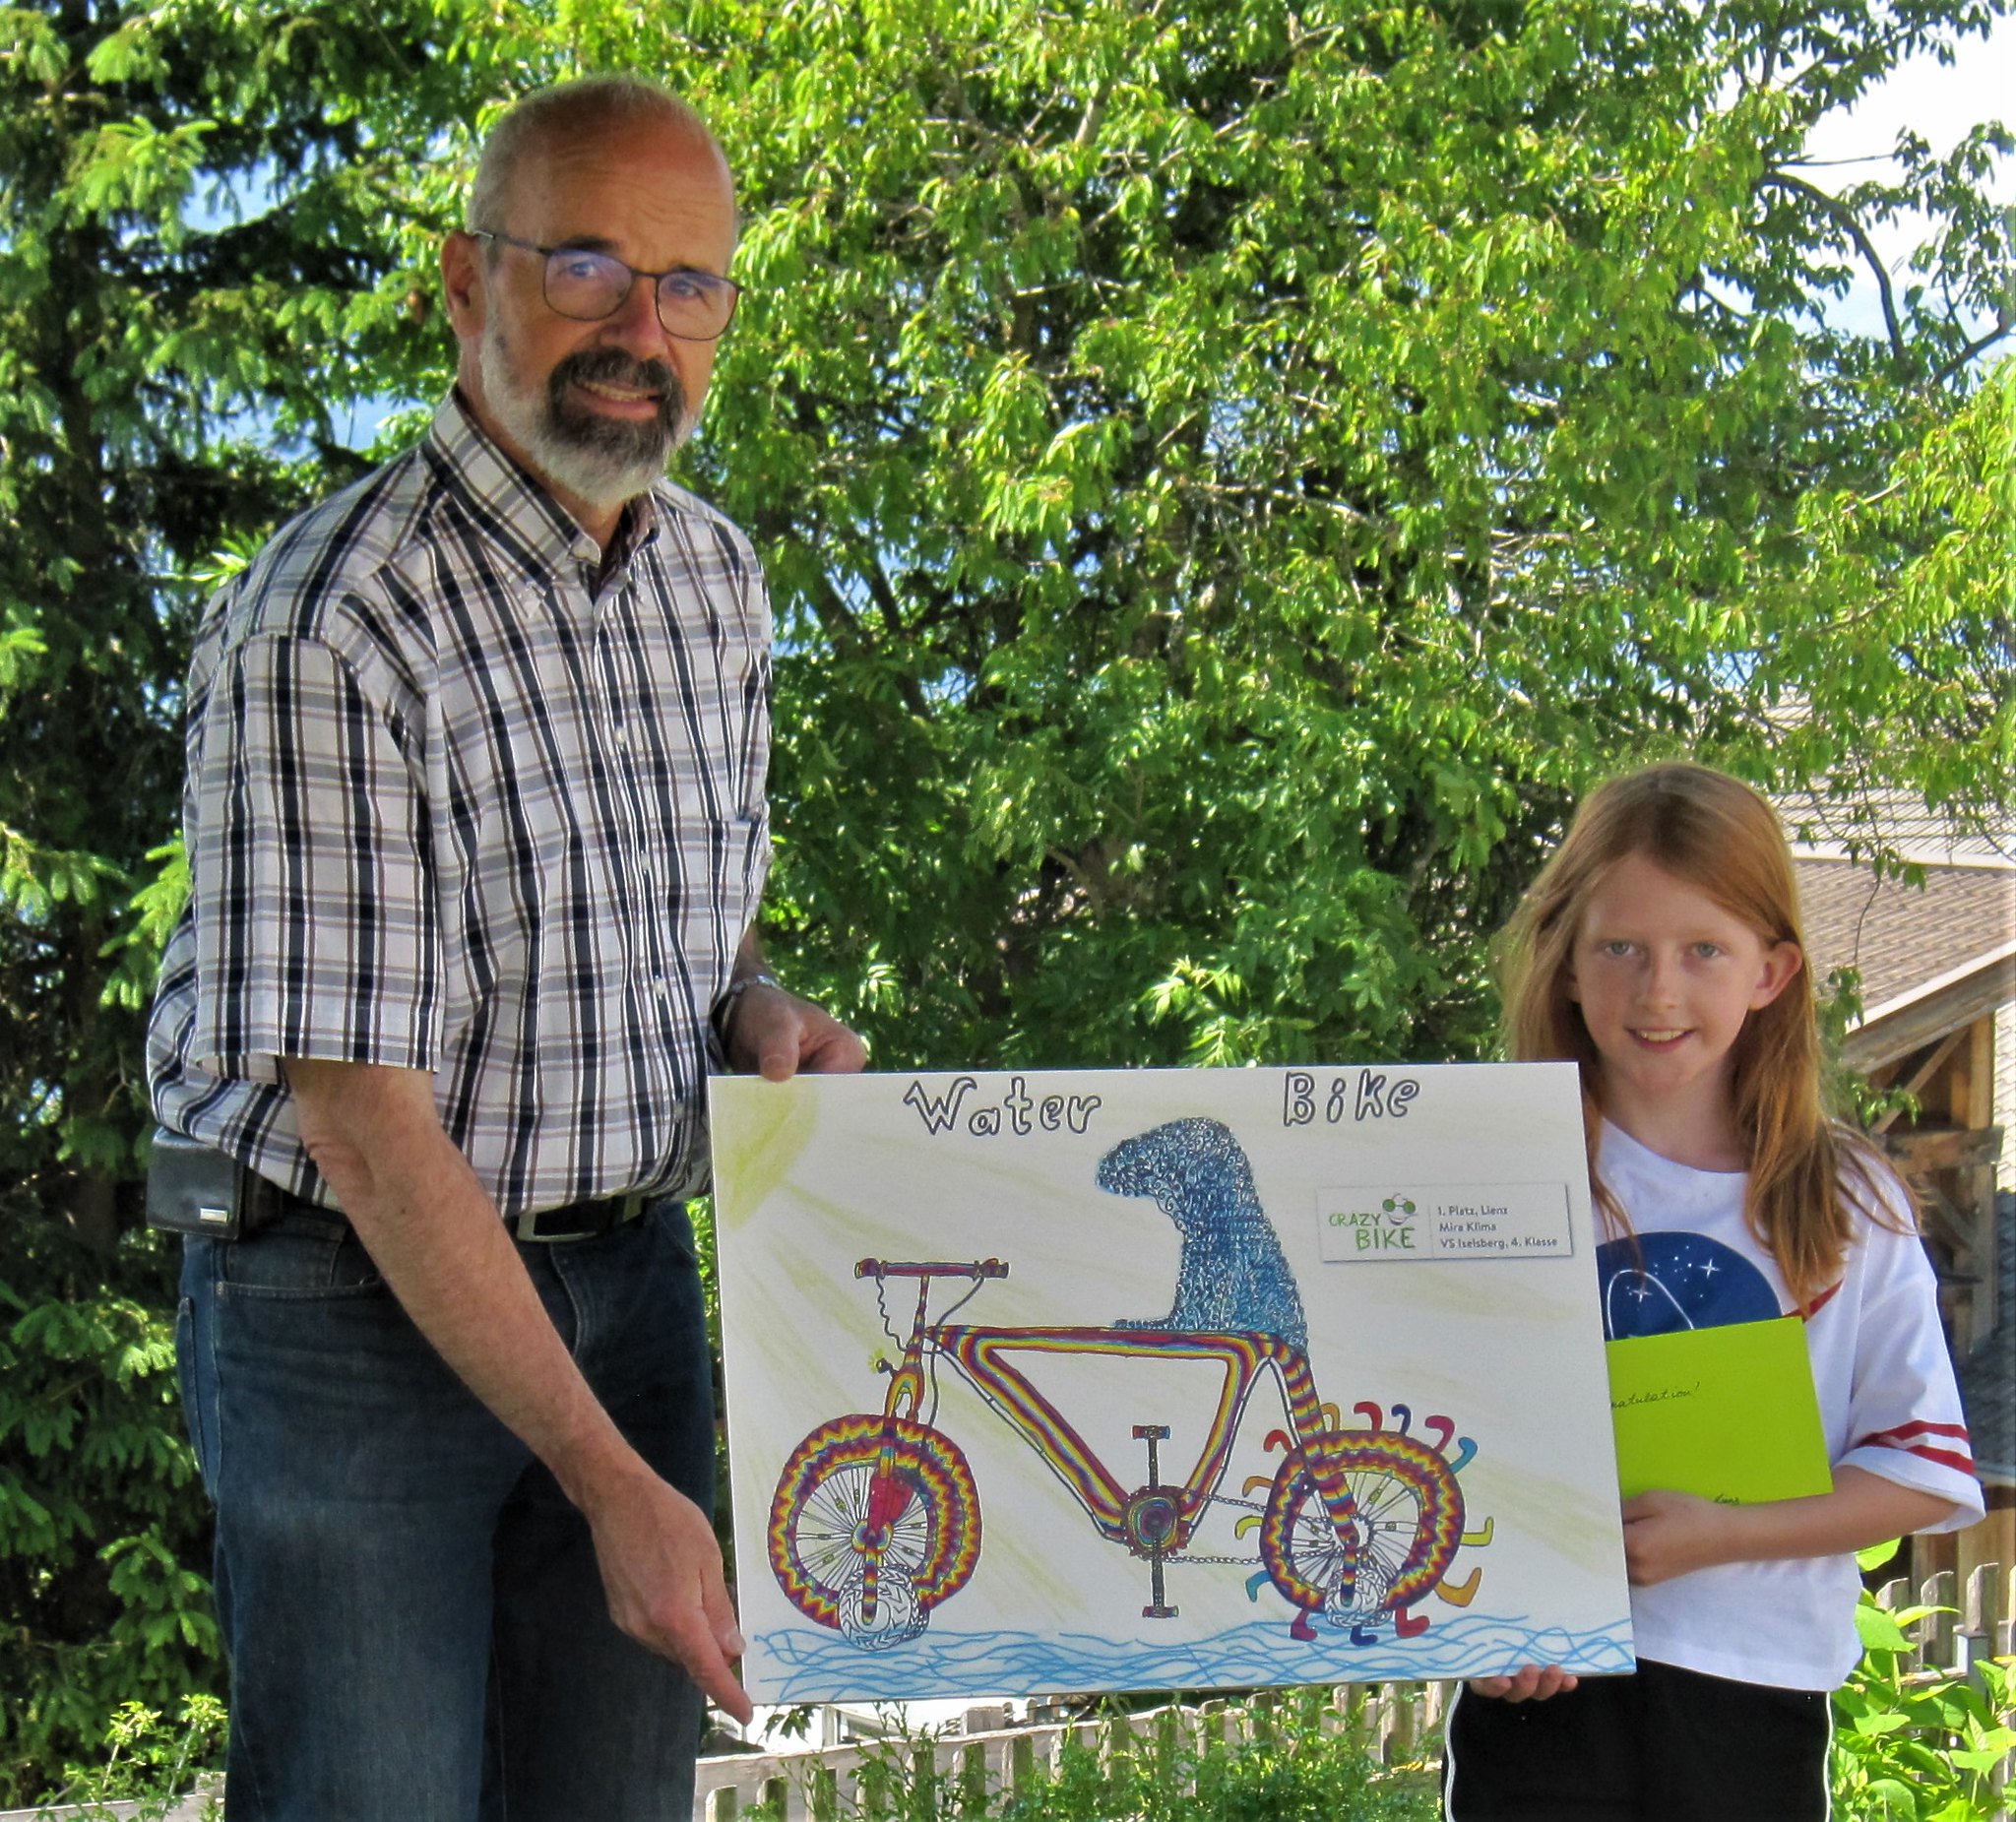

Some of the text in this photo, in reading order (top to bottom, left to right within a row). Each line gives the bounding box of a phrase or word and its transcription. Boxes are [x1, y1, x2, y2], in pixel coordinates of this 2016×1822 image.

[903, 1068, 1420, 1136] Water Bike
[1437, 1206, 1446, 1216] 1.
[1480, 1205, 1508, 1215] Lienz
[1329, 1213, 1381, 1226] CRAZY
[1439, 1221, 1496, 1231] Mira Klima
[1355, 1226, 1417, 1250] BIKE
[1440, 1236, 1557, 1250] VS Iselsberg, 4. Klasse
